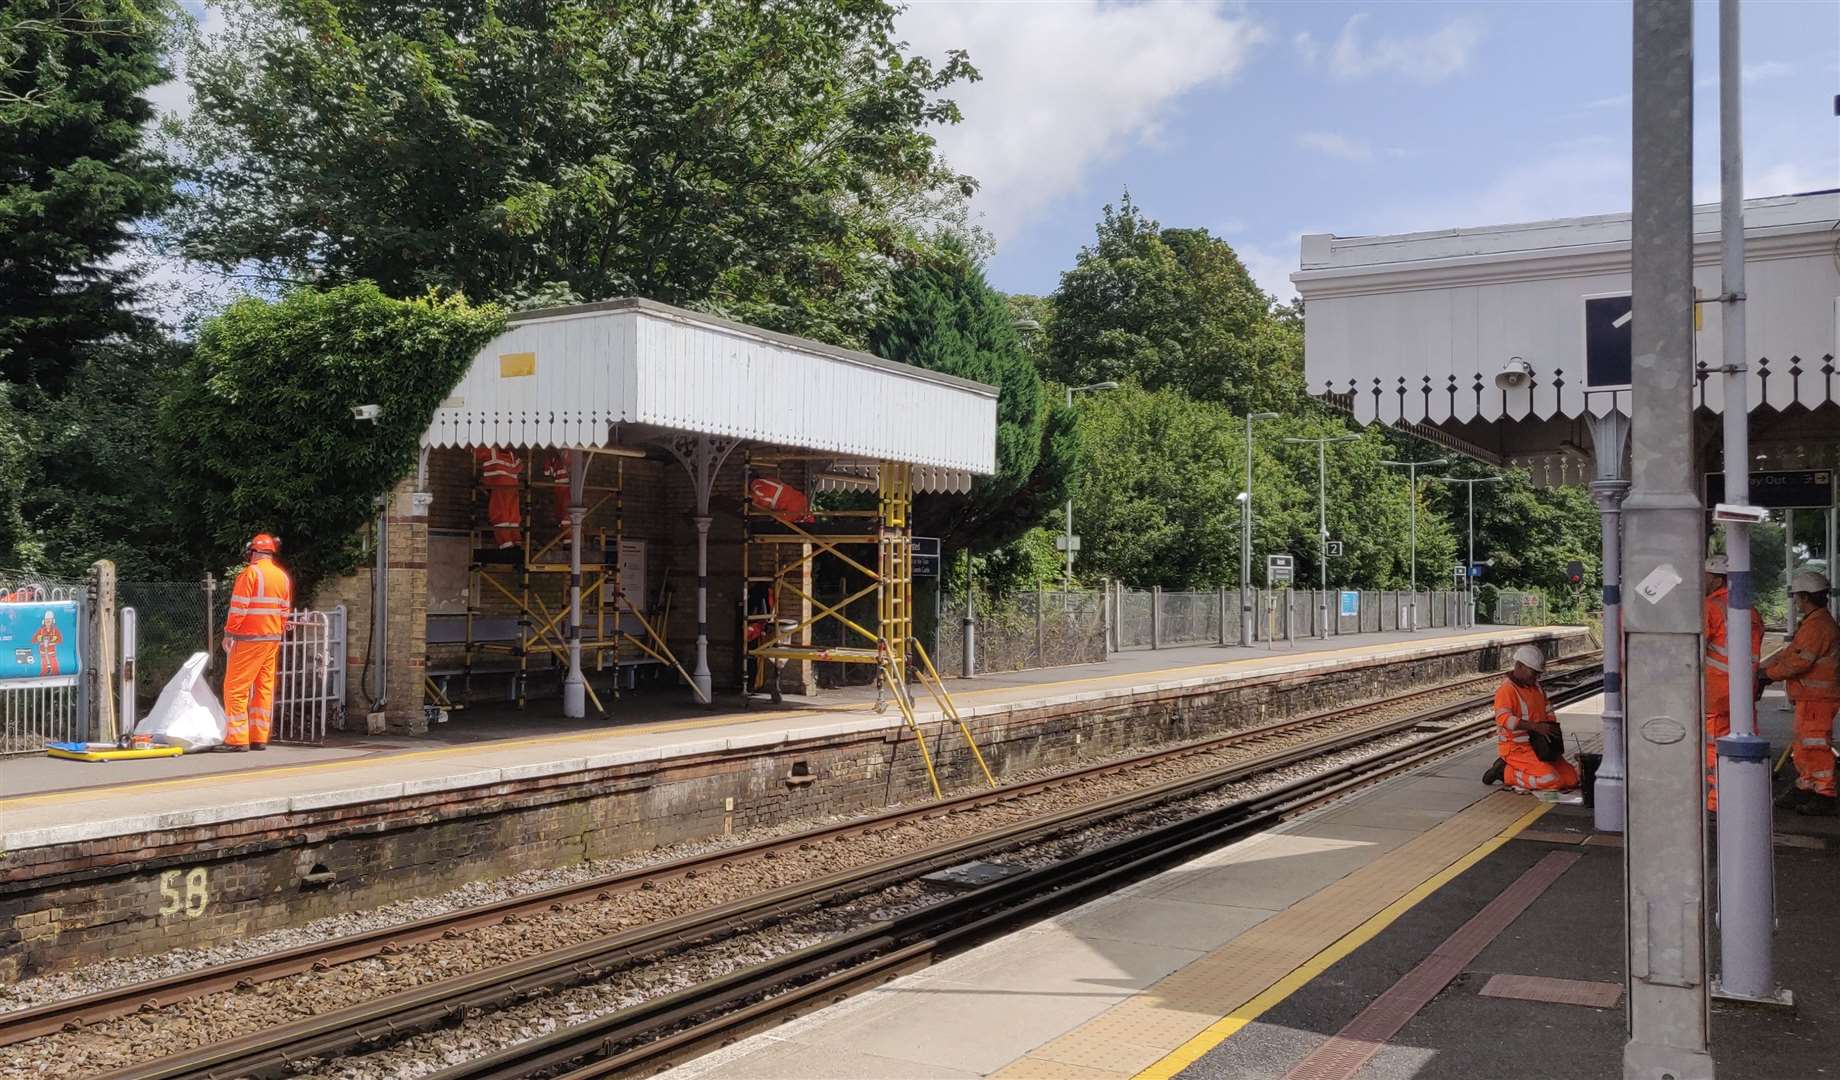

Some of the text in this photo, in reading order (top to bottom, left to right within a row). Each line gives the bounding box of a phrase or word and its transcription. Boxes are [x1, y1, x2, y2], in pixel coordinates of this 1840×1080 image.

[1766, 475, 1787, 485] Out
[1330, 544, 1337, 554] 2
[159, 867, 209, 918] 58
